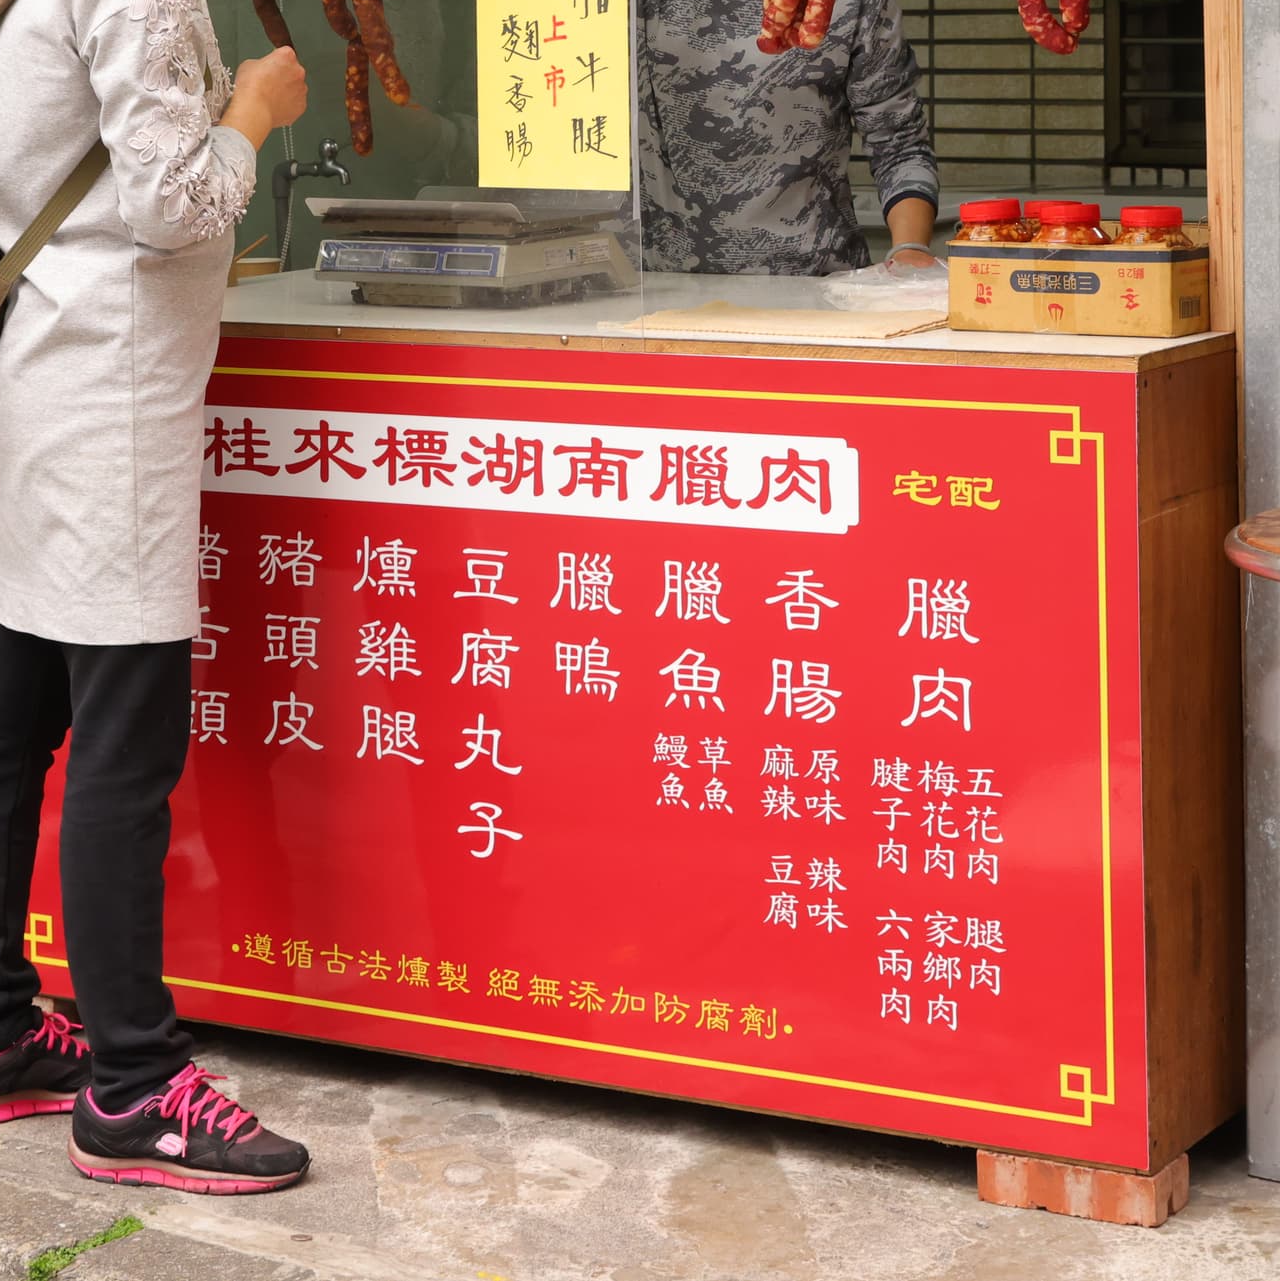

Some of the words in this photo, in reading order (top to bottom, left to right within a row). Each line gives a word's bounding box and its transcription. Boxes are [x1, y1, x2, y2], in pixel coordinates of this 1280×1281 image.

[543, 15, 568, 107] 上市
[204, 416, 832, 517] 桂來標湖南臘肉
[891, 470, 1001, 510] 宅配
[259, 531, 324, 751] 豬頭皮
[353, 535, 425, 766] 燻雞腿
[551, 552, 623, 702] 臘鴨
[655, 560, 731, 712] 臘魚
[764, 570, 843, 723] 香腸
[898, 578, 980, 731] 臘肉
[451, 547, 524, 860] 豆腐丸子
[653, 733, 691, 809] 鰻魚
[697, 736, 734, 814] 草魚
[760, 745, 801, 820] 麻辣
[804, 749, 847, 825] 原味
[870, 757, 913, 874] 腱子肉
[917, 760, 960, 880] 梅花肉
[962, 768, 1005, 885] 五花肉
[763, 855, 801, 929] 豆腐
[805, 856, 848, 933] 辣味
[245, 933, 471, 995] 遵循古法燻製
[485, 967, 779, 1040] 絕無添加防腐劑
[875, 909, 913, 1024] 六兩肉
[922, 910, 963, 1031] 家鄉肉
[963, 917, 1007, 996] 腿肉
